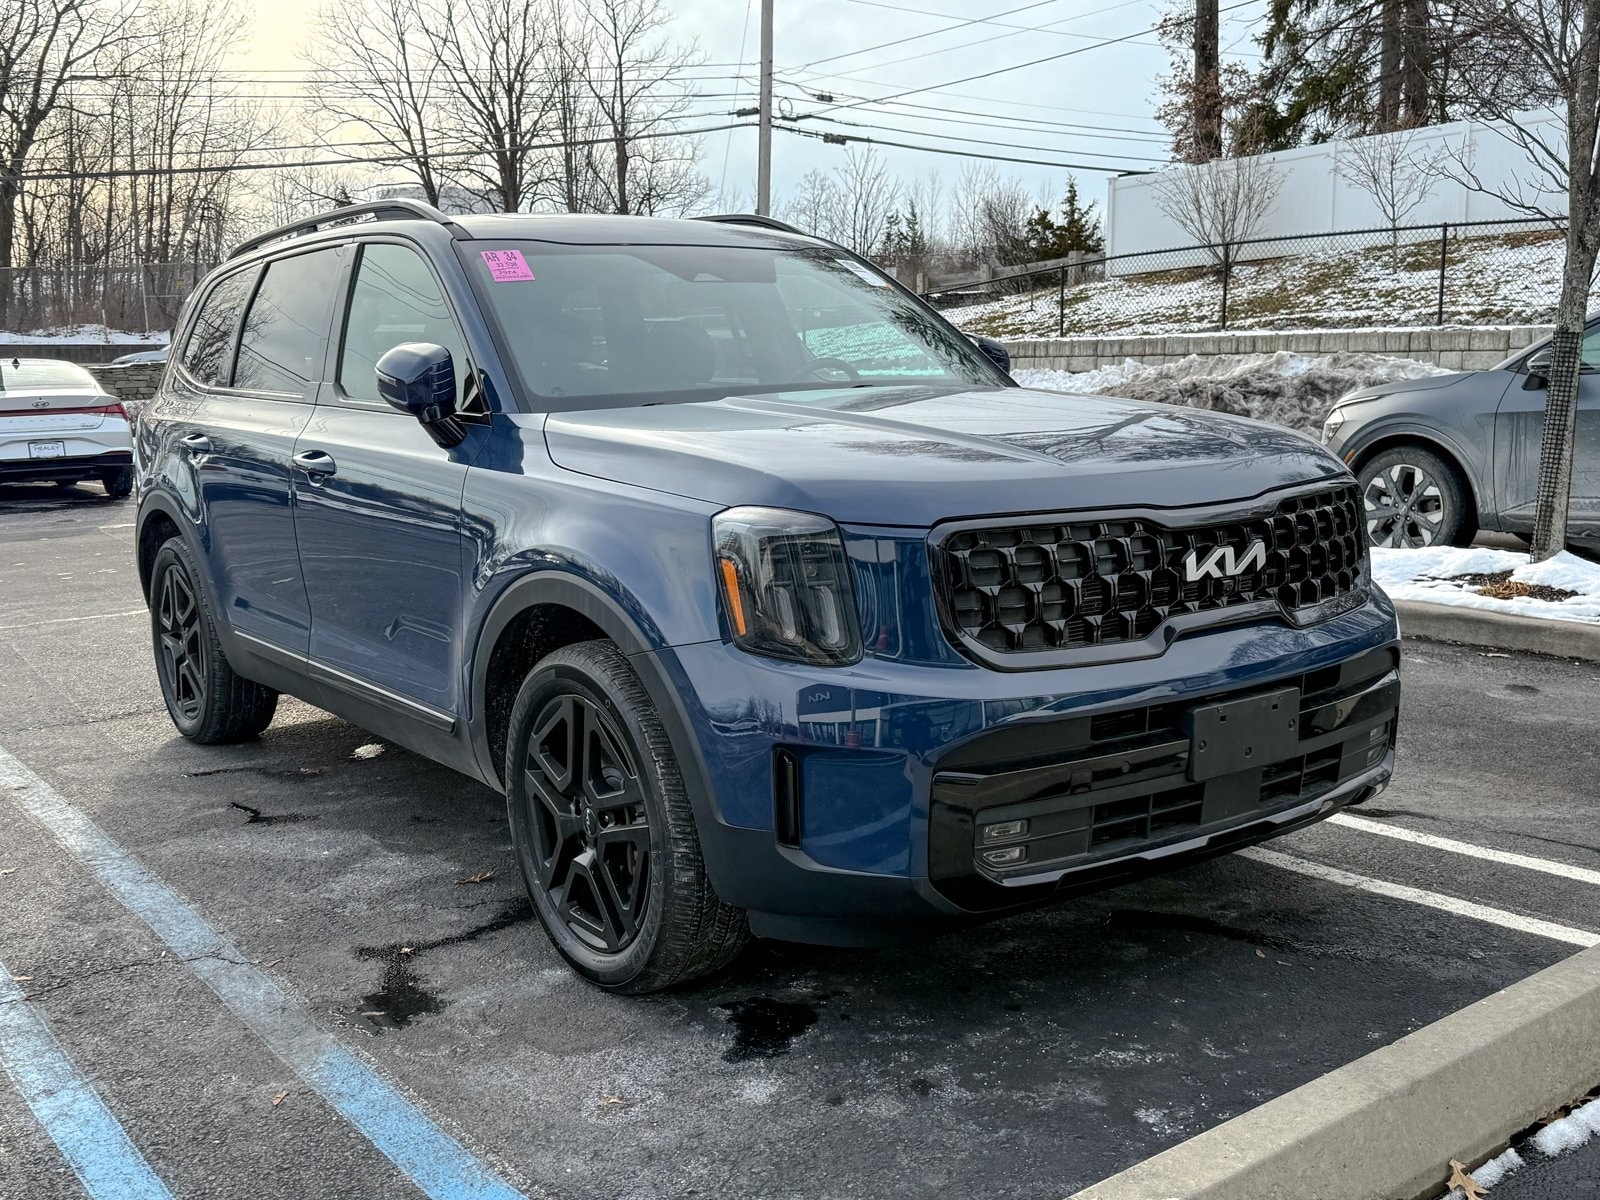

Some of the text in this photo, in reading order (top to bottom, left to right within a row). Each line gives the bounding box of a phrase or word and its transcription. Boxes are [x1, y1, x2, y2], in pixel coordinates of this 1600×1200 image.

[485, 251, 517, 262] AR 34
[1182, 539, 1266, 582] KIA
